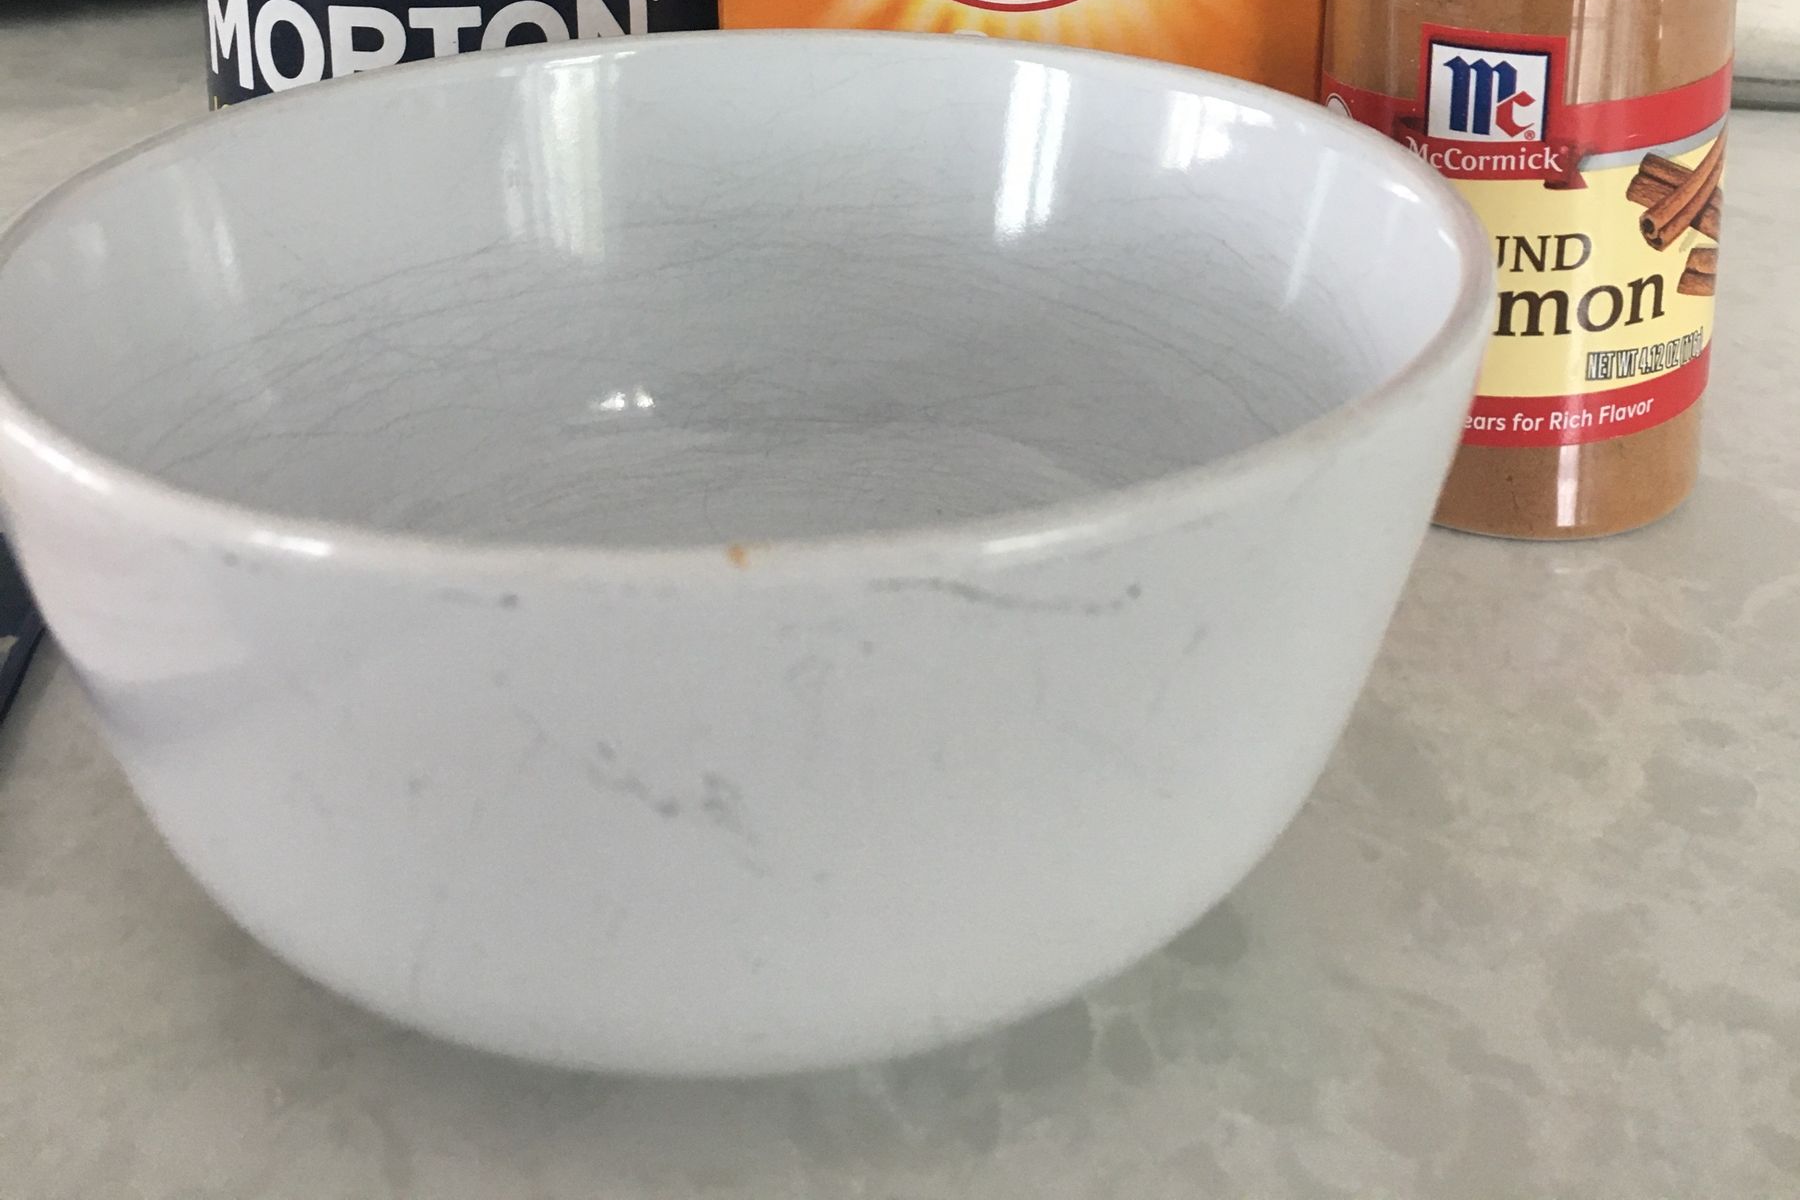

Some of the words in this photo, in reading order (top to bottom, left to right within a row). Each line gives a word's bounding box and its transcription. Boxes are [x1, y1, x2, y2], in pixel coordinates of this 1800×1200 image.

[1584, 351, 1616, 381] NET
[1615, 348, 1639, 379] WT
[1638, 342, 1666, 375] 4.12
[1512, 412, 1545, 432] for
[1549, 408, 1593, 430] Rich
[1599, 397, 1655, 425] Flavor
